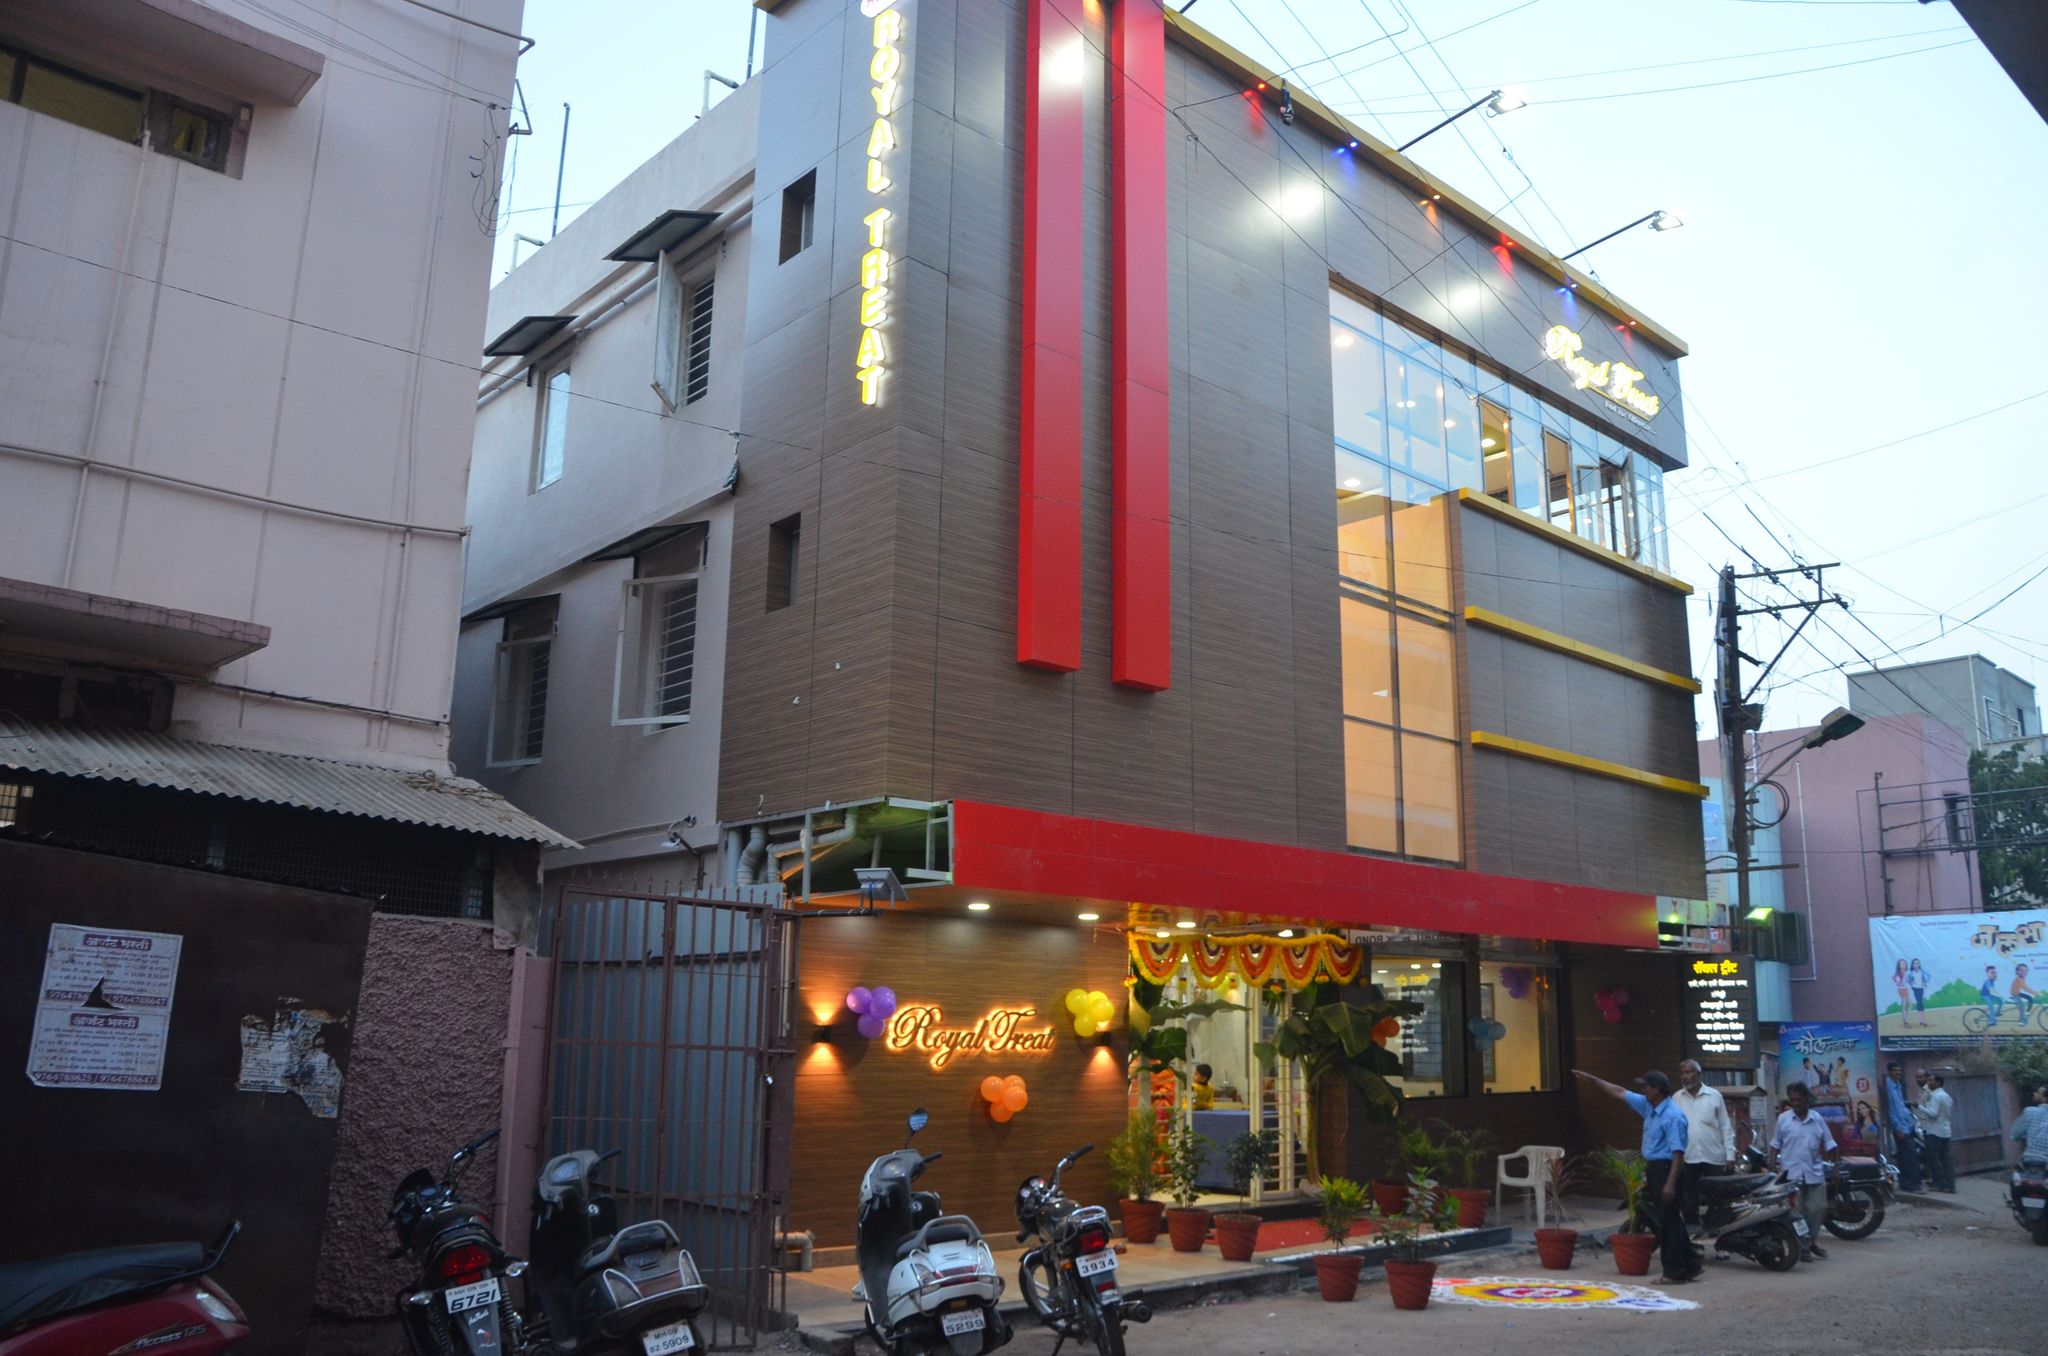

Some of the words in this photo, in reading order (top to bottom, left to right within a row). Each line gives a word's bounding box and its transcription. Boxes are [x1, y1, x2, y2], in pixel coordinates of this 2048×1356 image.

[866, 8, 901, 194] ROYAL
[856, 207, 892, 406] TREAT
[891, 1006, 988, 1068] Royal
[988, 1008, 1056, 1051] Treat
[1081, 1258, 1115, 1273] 3934
[451, 1289, 496, 1311] 6721
